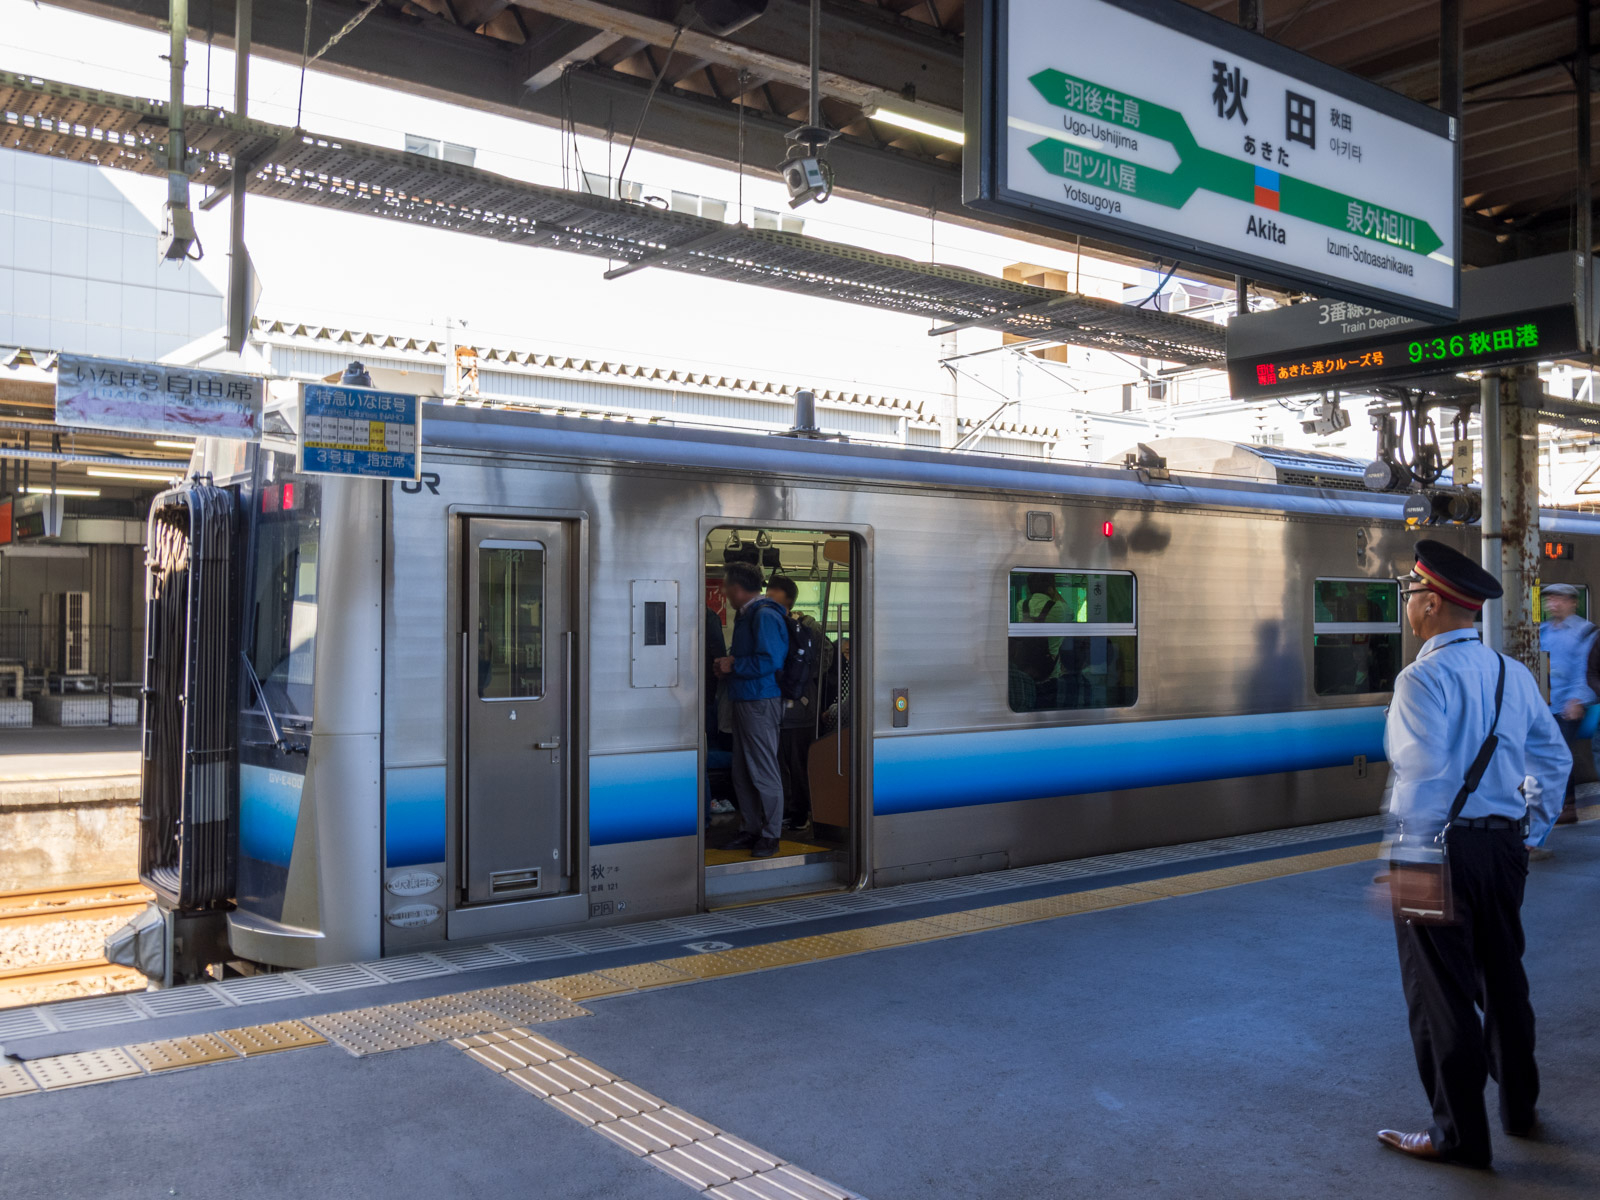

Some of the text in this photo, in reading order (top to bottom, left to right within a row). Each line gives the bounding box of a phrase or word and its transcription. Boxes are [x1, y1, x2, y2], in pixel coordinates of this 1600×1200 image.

[1064, 79, 1140, 128] 羽後牛島
[1212, 60, 1316, 150] 秋田
[1063, 115, 1138, 151] Ugo-Ushijima
[1329, 108, 1352, 133] 秋田
[1243, 135, 1290, 167] あきた
[1329, 138, 1362, 163] 아키타
[1063, 148, 1137, 193] 四ツ小屋
[1063, 184, 1121, 214] Yotsugoya
[1246, 215, 1286, 245] Akita
[1346, 201, 1416, 250] 泉外旭川
[1326, 237, 1415, 277] Izumi-Sotoasahikawa
[1341, 321, 1366, 334] Train
[1278, 324, 1539, 379] あきた港クルーズ号 9:36 秋田港
[77, 366, 253, 400] いなほ号 自由席
[316, 390, 407, 413] 特急いなほ号
[316, 450, 405, 469] 3号車 指定席
[591, 864, 605, 880] 秋
